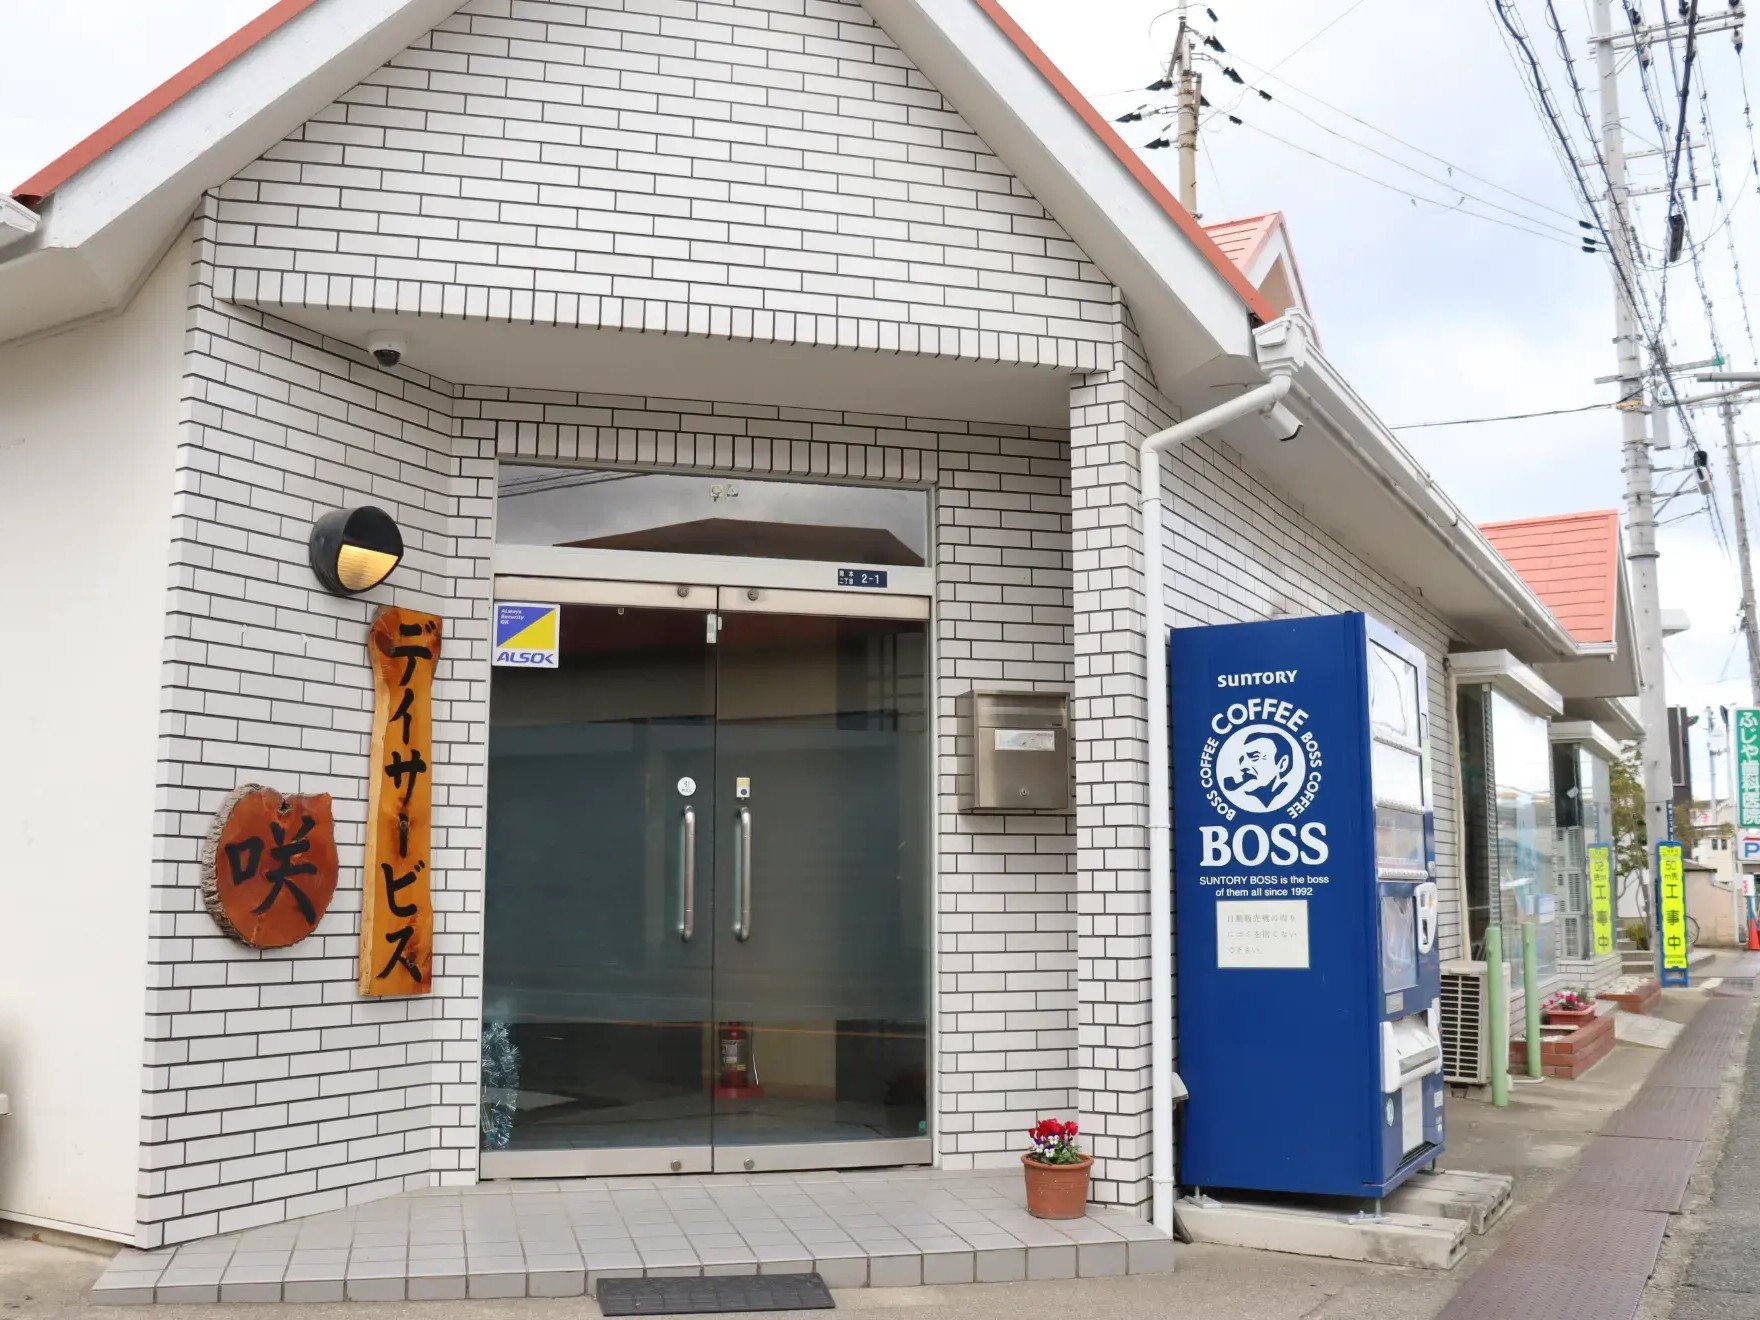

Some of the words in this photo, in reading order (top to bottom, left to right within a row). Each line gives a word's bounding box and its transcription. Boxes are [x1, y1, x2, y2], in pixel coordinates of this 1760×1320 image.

[861, 573, 879, 584] 2-1
[496, 651, 555, 665] ALSOK
[1217, 670, 1298, 687] SUNTORY
[1211, 697, 1310, 735] COFFEE
[1199, 736, 1220, 788] COFFEE
[1300, 731, 1323, 768] BOSS
[1206, 790, 1237, 821] BOSS
[1286, 771, 1322, 820] COFFEE
[1199, 822, 1329, 867] BOSS
[1744, 842, 1760, 858] P
[224, 815, 318, 926] 咲
[1199, 876, 1247, 885] SUNTORY
[1250, 876, 1278, 885] BOSS
[1280, 875, 1288, 884] is
[1290, 875, 1305, 884] the
[1307, 875, 1329, 884] boss
[1665, 860, 1677, 871] 50
[1215, 888, 1224, 897] of
[1226, 888, 1248, 897] them
[1251, 888, 1262, 896] all
[1264, 887, 1288, 896] since
[1291, 887, 1313, 896] 1992
[1665, 884, 1681, 951] 工事中
